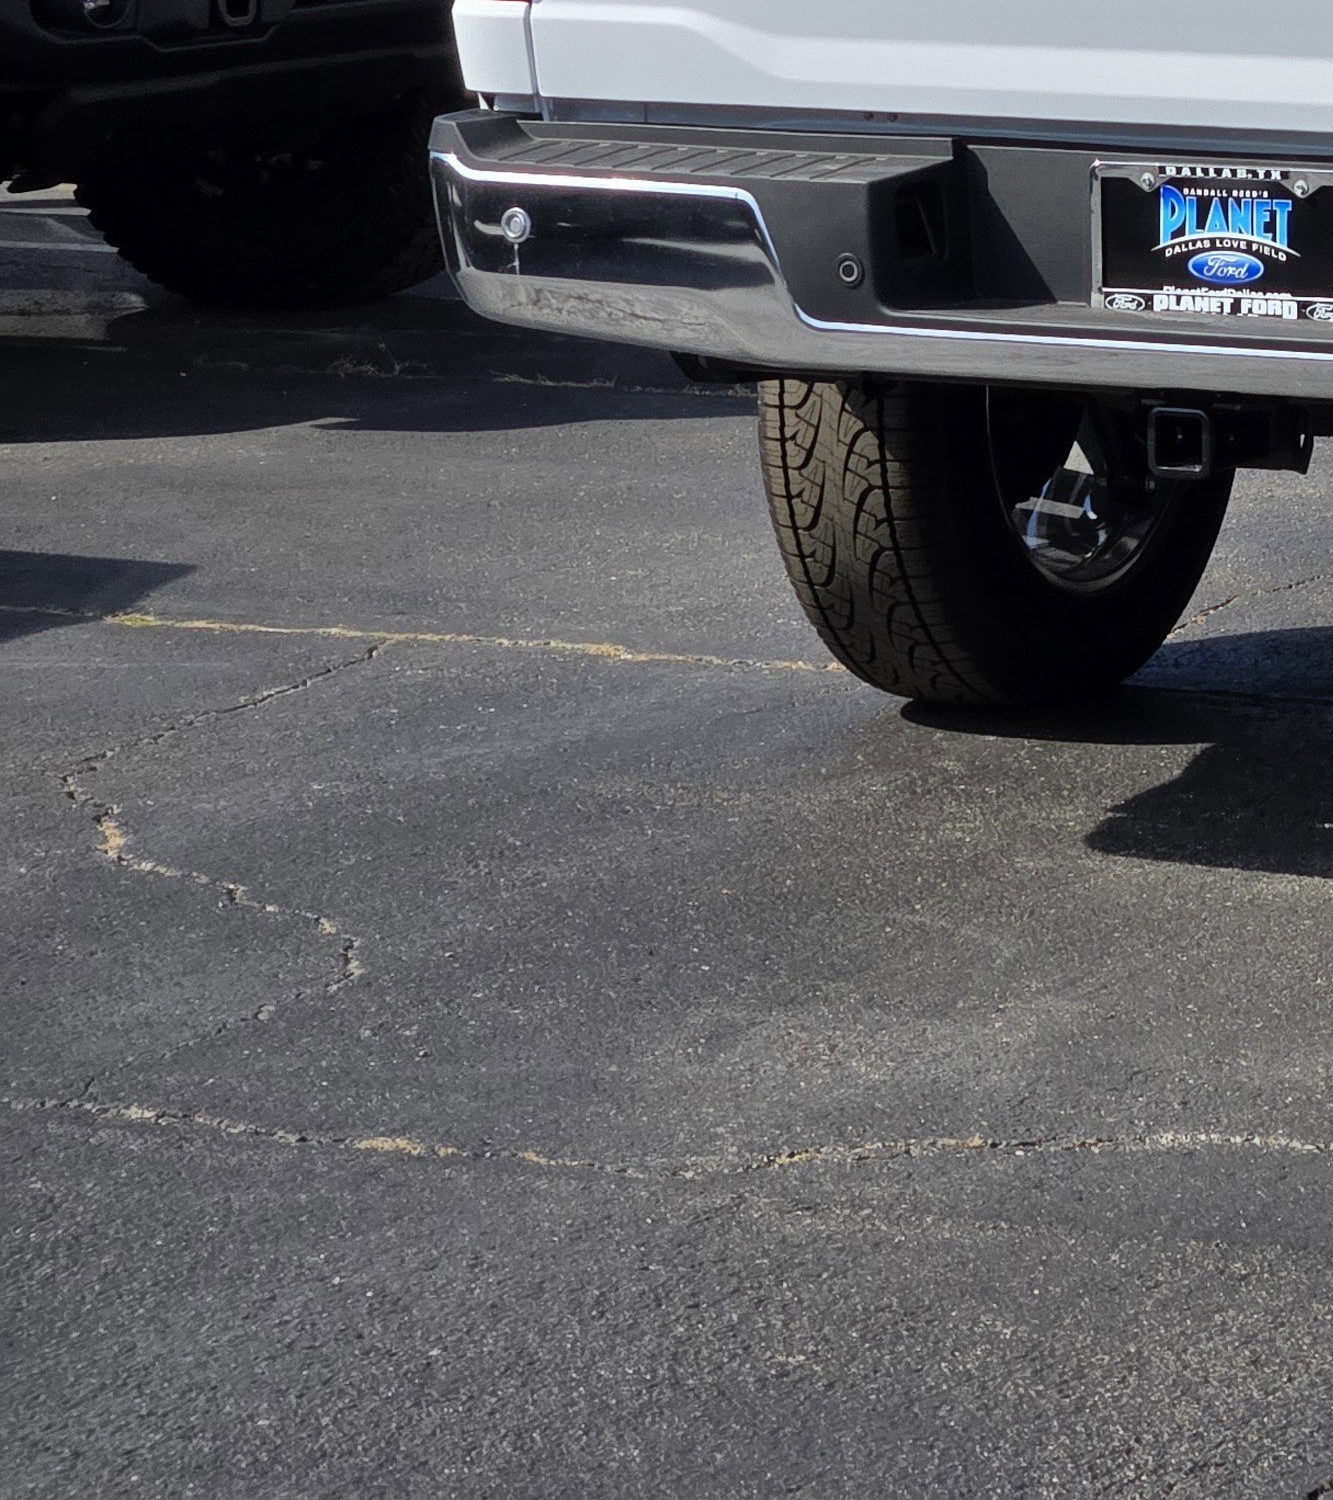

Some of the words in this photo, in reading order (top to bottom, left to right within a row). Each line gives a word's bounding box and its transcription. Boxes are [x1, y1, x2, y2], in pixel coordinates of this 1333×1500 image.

[1256, 169, 1281, 180] TX
[1159, 183, 1293, 248] PLANET
[1165, 239, 1211, 258] DALLAS
[1215, 238, 1248, 250] LOVE
[1252, 243, 1287, 262] FIELD
[1203, 257, 1249, 279] Ford
[1112, 297, 1137, 311] Ford
[1153, 294, 1234, 314] PLANET
[1240, 298, 1298, 320] FORD
